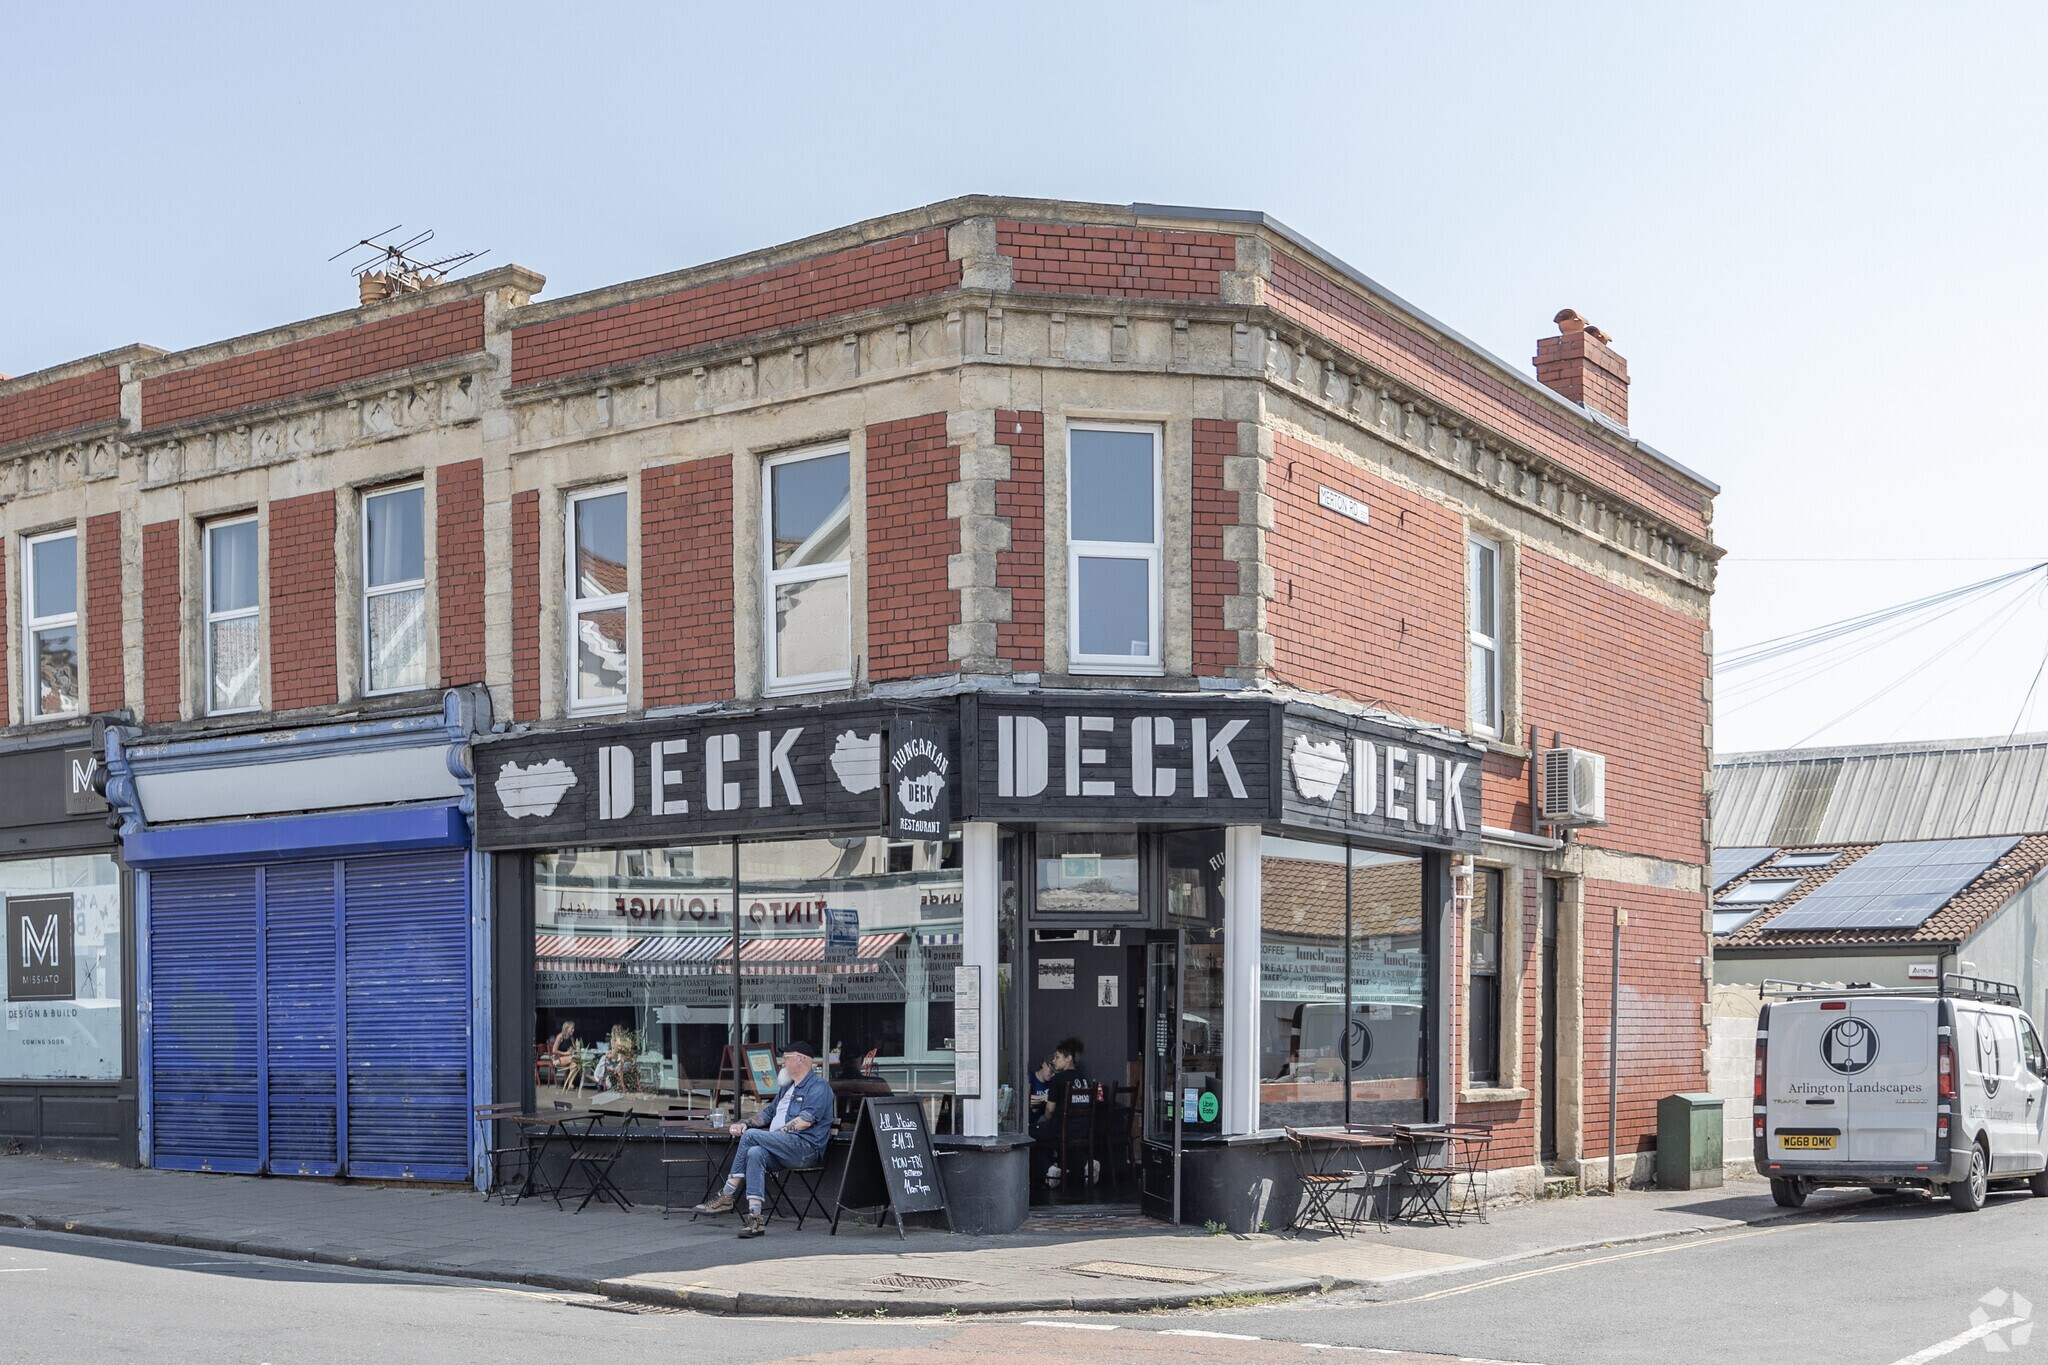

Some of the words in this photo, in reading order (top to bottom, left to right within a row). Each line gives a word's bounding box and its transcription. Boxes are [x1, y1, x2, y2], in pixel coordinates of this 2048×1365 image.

[891, 737, 949, 775] HUNGARIAN
[998, 715, 1250, 799] DECK
[598, 727, 805, 820] DECK
[1352, 738, 1468, 831] DECK
[908, 783, 934, 804] DECK
[900, 817, 941, 834] RESTAURANT
[21, 914, 59, 968] M
[22, 974, 60, 984] MISSIATO
[536, 971, 590, 982] BREAKFAST
[848, 976, 874, 984] DINNER
[536, 982, 558, 990] DINNER
[607, 988, 632, 999] lunch
[8, 1009, 40, 1018] DESIGN
[43, 1009, 48, 1018] &
[51, 1008, 78, 1018] BUILD
[1788, 1082, 1845, 1095] Arlington
[1848, 1082, 1923, 1095] Landscapes
[1202, 1100, 1214, 1108] Uber
[1202, 1107, 1214, 1115] Eats
[879, 1112, 893, 1129] All
[1783, 1136, 1810, 1147] WG68
[1811, 1136, 1832, 1147] OMK
